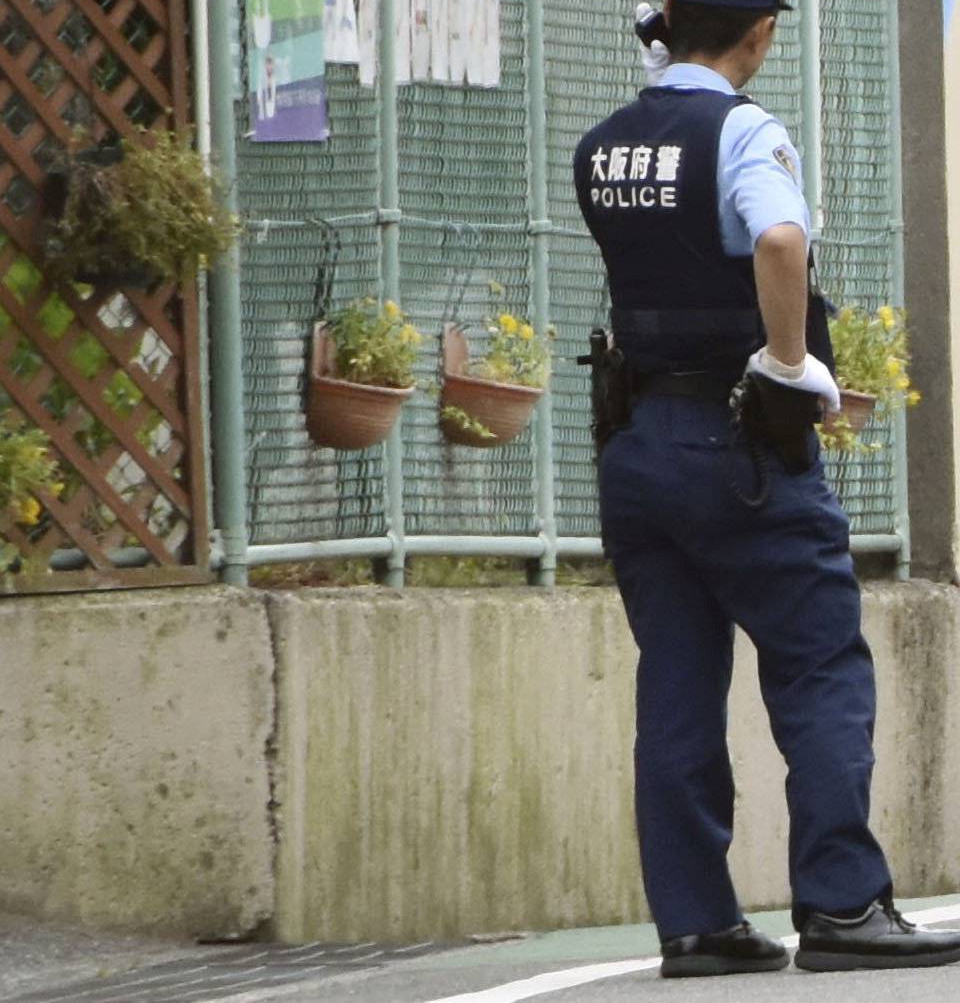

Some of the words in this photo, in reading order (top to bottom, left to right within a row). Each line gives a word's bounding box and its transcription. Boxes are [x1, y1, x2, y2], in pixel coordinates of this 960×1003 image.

[590, 145, 681, 181] 大阪府警
[590, 186, 676, 207] POLICE
